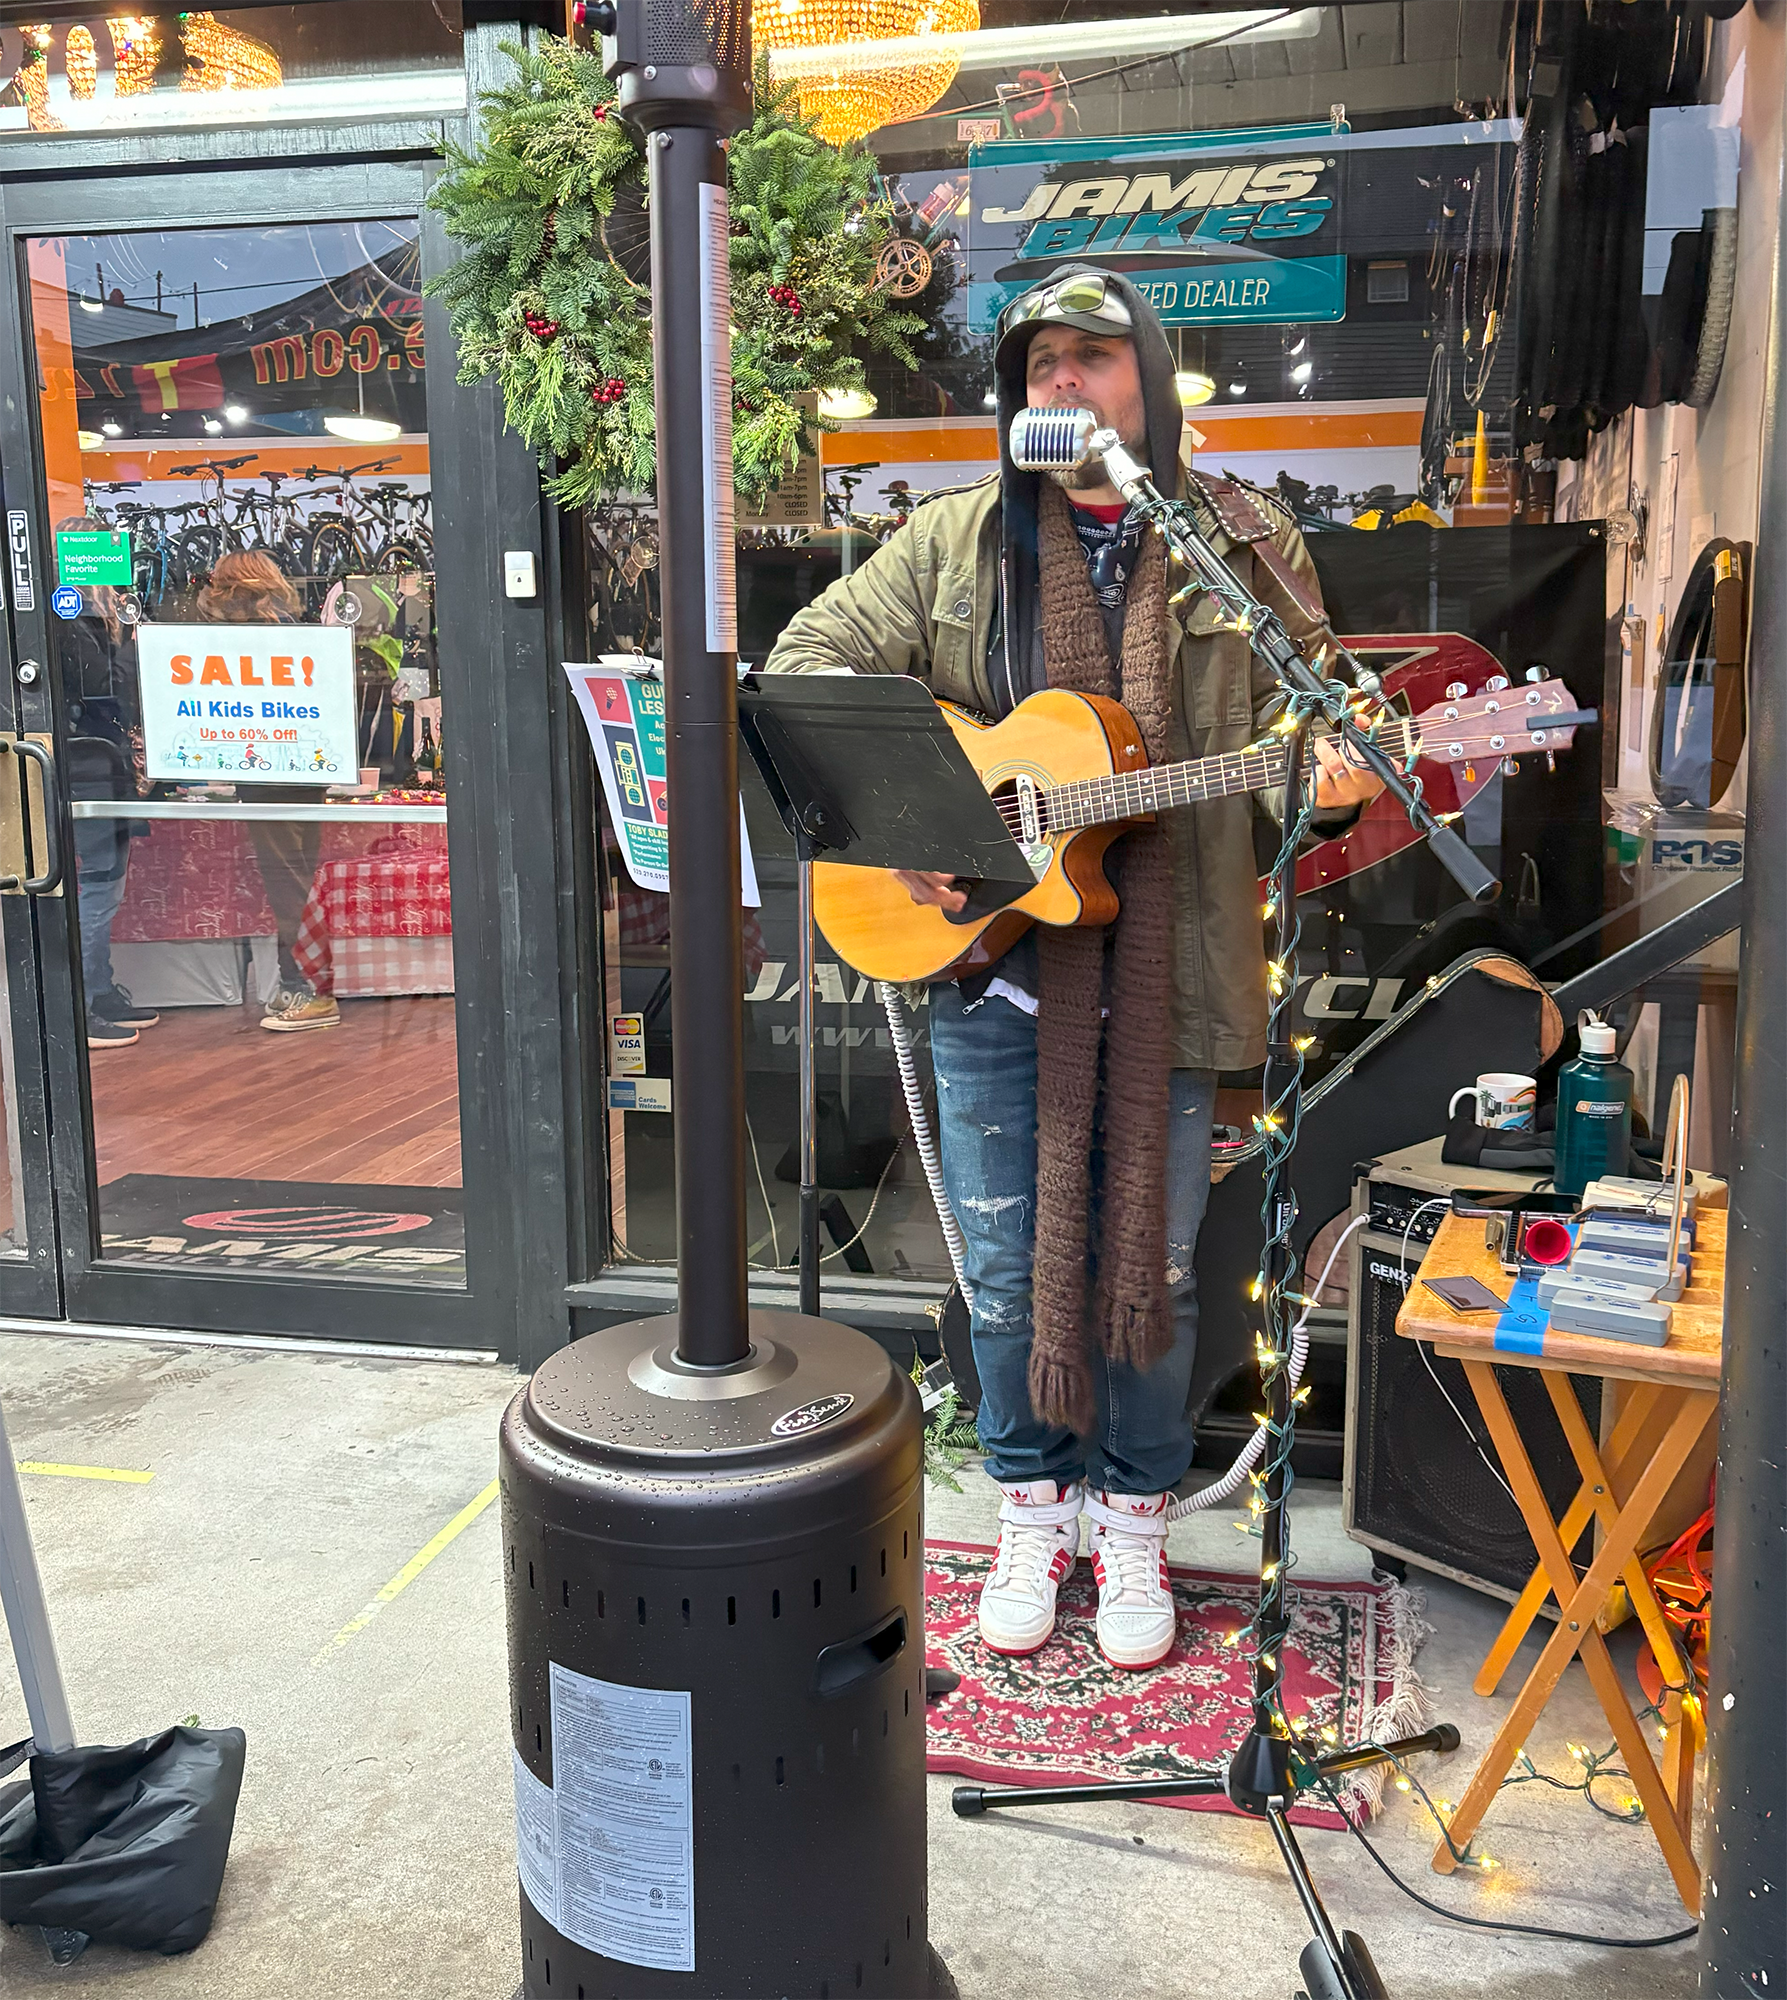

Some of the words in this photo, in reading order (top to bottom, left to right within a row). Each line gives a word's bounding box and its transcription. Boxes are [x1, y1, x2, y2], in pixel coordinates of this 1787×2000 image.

[982, 157, 1327, 223] JAMIS
[1017, 197, 1334, 258] BIKES
[1184, 278, 1270, 308] DEALER
[11, 519, 29, 586] PULL
[64, 555, 123, 564] Neighborhood
[65, 565, 98, 573] Favorite
[58, 595, 77, 609] ADT
[170, 655, 315, 687] SALE!
[177, 700, 203, 718] All
[209, 701, 254, 719] Kids
[261, 701, 320, 719] Bikes
[199, 728, 218, 741] Up
[221, 729, 235, 740] to
[238, 728, 269, 741] 60%
[273, 728, 298, 740] Off!
[627, 824, 647, 836] TOBY
[617, 1039, 641, 1048] VISA
